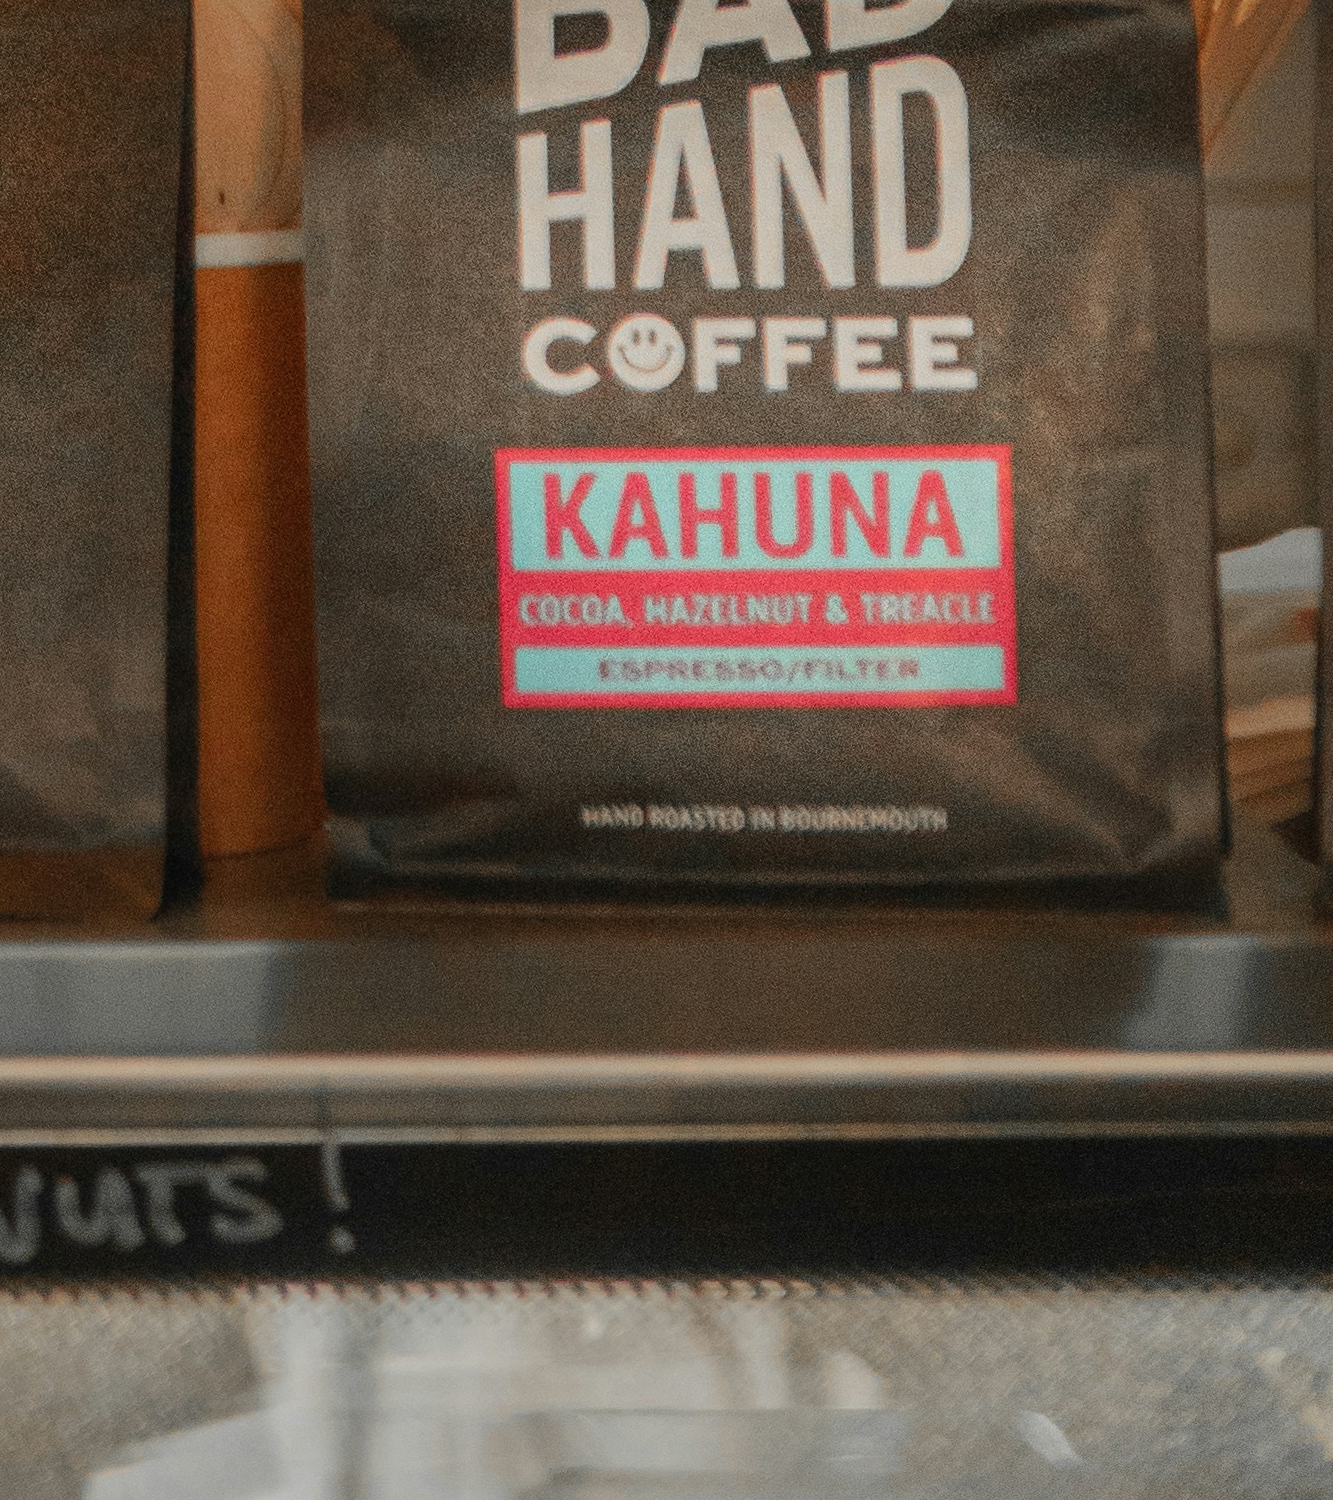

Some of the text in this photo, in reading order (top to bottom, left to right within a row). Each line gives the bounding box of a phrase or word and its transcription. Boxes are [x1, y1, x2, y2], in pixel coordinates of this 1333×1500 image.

[516, 53, 974, 292] HAND
[542, 470, 965, 560] KAHUNA
[517, 591, 996, 628] COCOA, HAZELNUT & TREACLE
[597, 654, 922, 684] ESPRESSO/FILTER
[581, 803, 645, 830] HAND
[648, 804, 746, 832] ROASTED
[780, 804, 949, 833] BOURNEMOUTH
